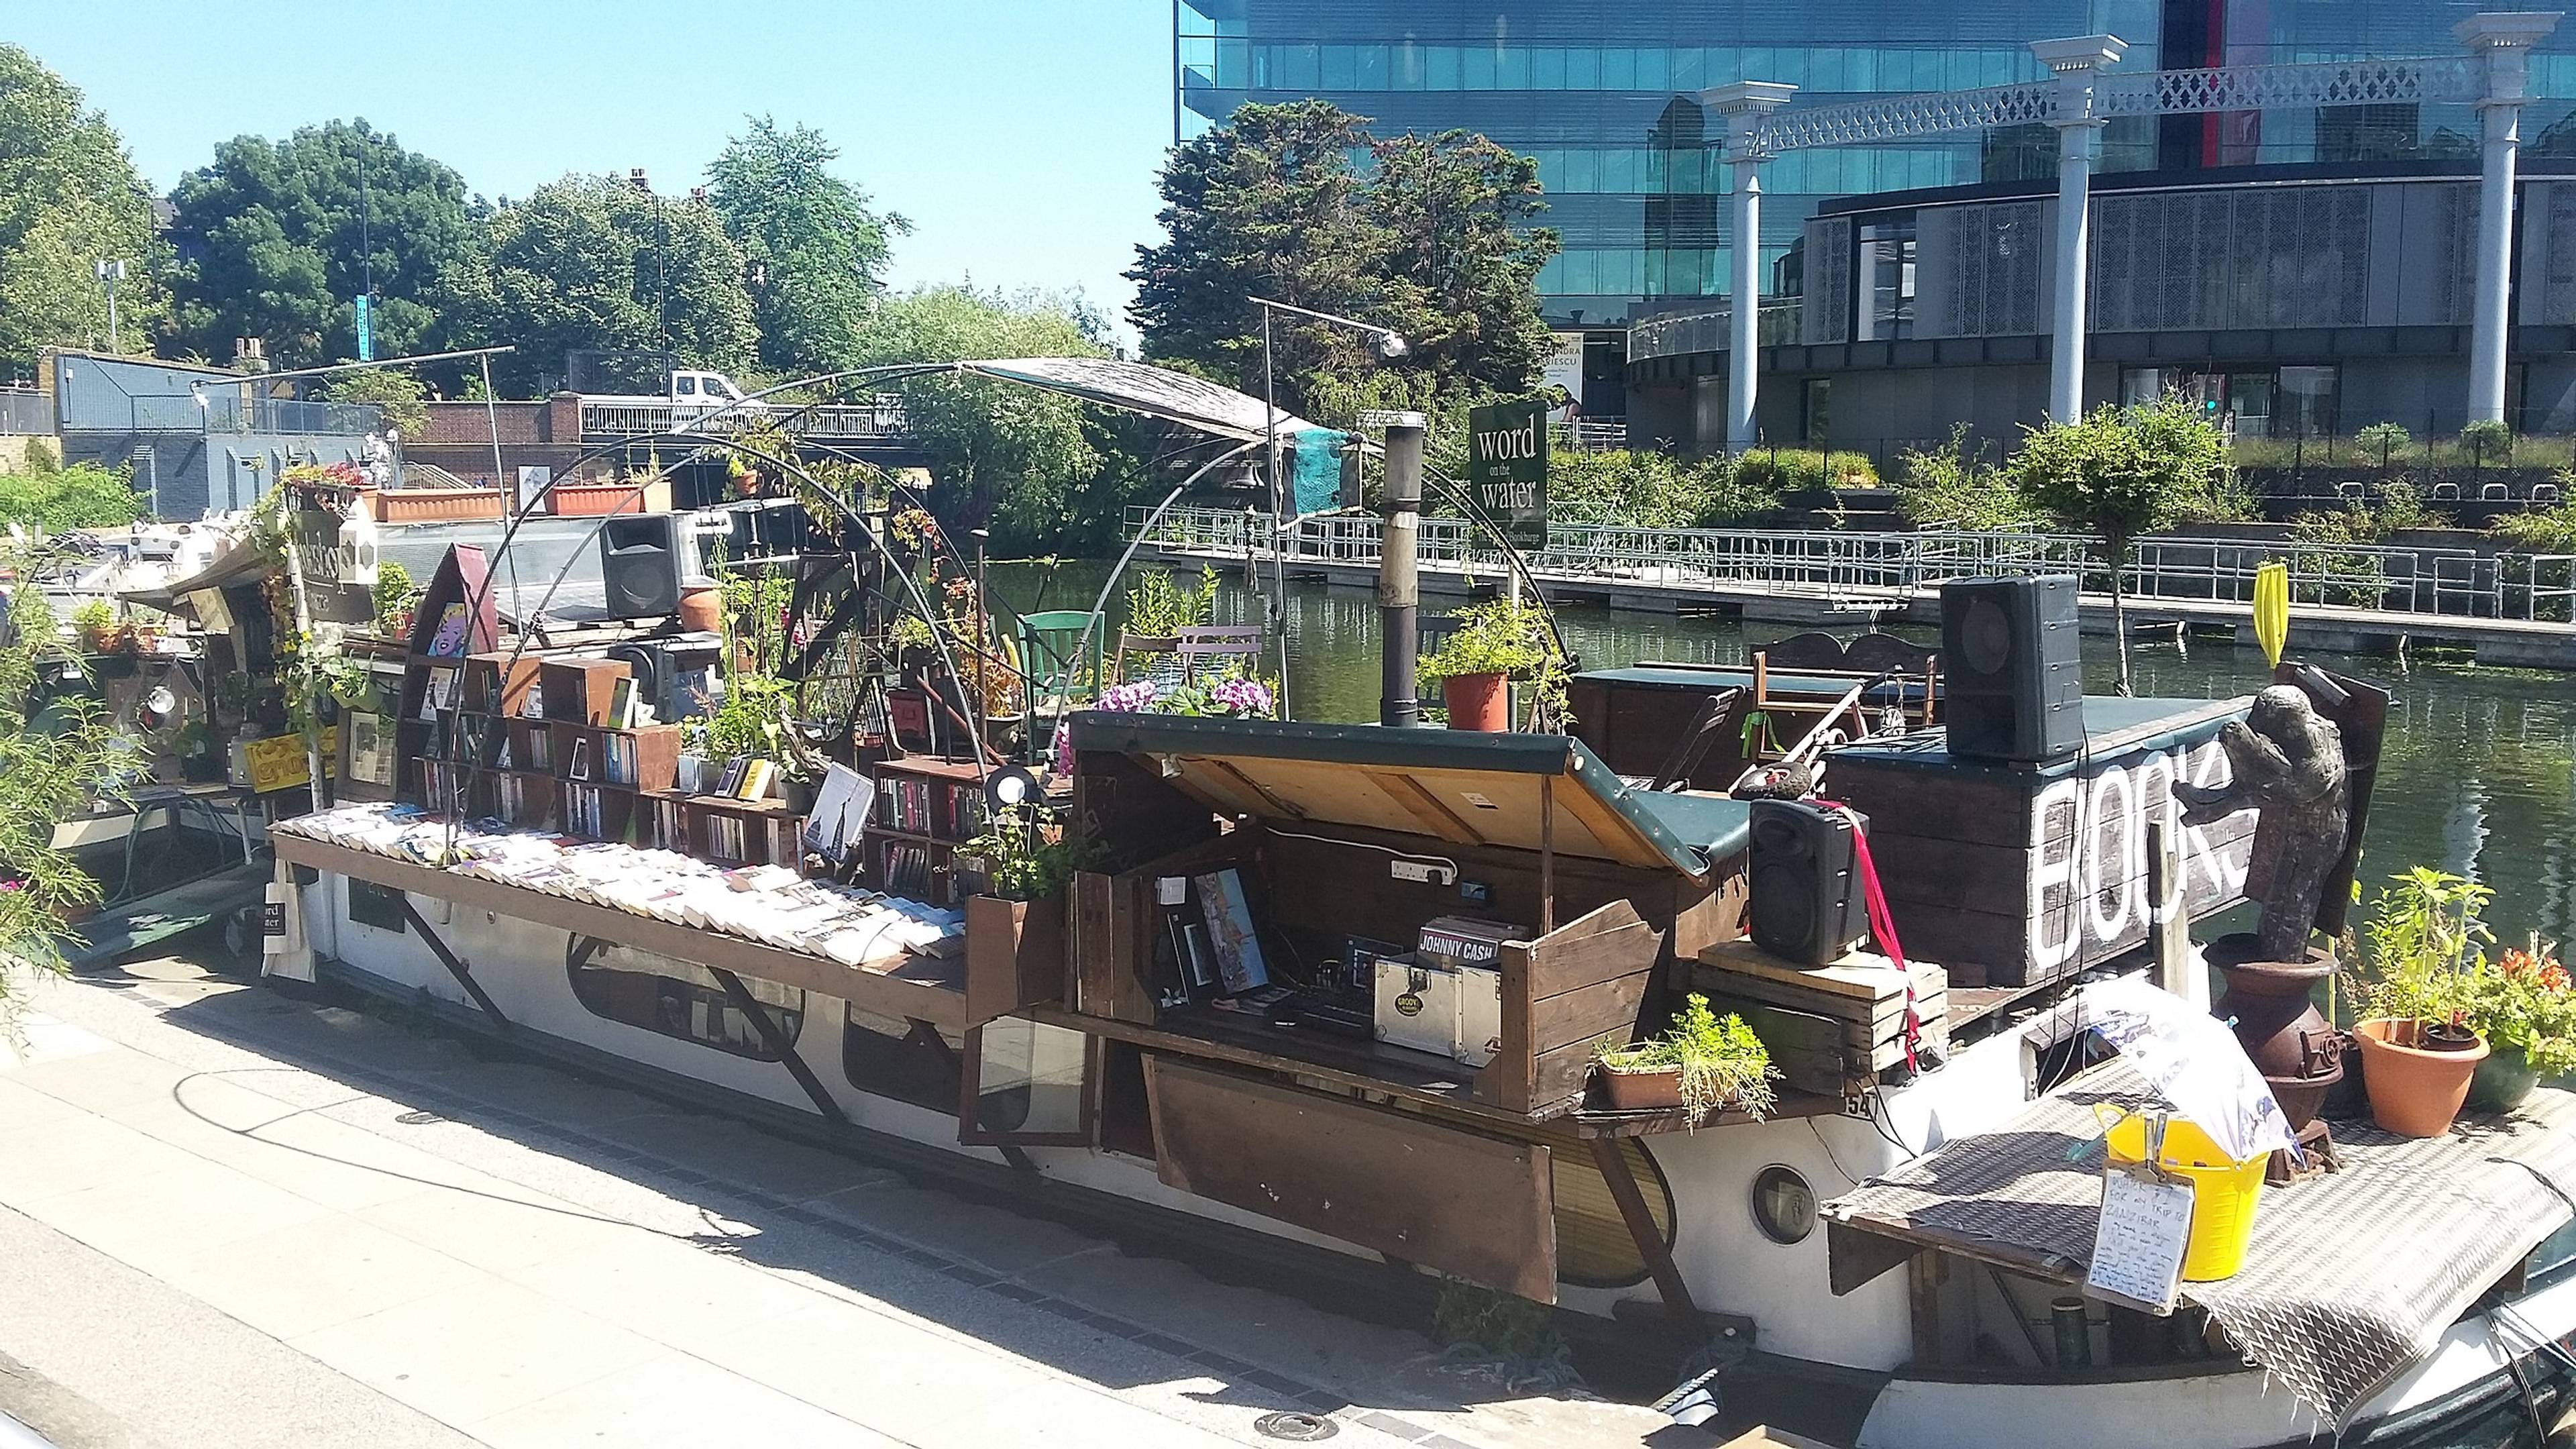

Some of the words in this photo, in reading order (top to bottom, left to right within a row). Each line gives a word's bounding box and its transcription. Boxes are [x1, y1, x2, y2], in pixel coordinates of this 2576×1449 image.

[1477, 413, 1537, 462] word
[1489, 467, 1498, 476] on
[1498, 463, 1511, 476] the
[1481, 478, 1537, 510] water
[1509, 531, 1540, 545] Bookbarge
[1419, 934, 1462, 957] JOHNNY
[1462, 943, 1493, 961] CASH
[2105, 1204, 2161, 1229] ZANZIBAR
[2110, 1189, 2128, 1203] FOR
[2151, 1205, 2172, 1218] TRIP
[2175, 1212, 2186, 1222] TO
